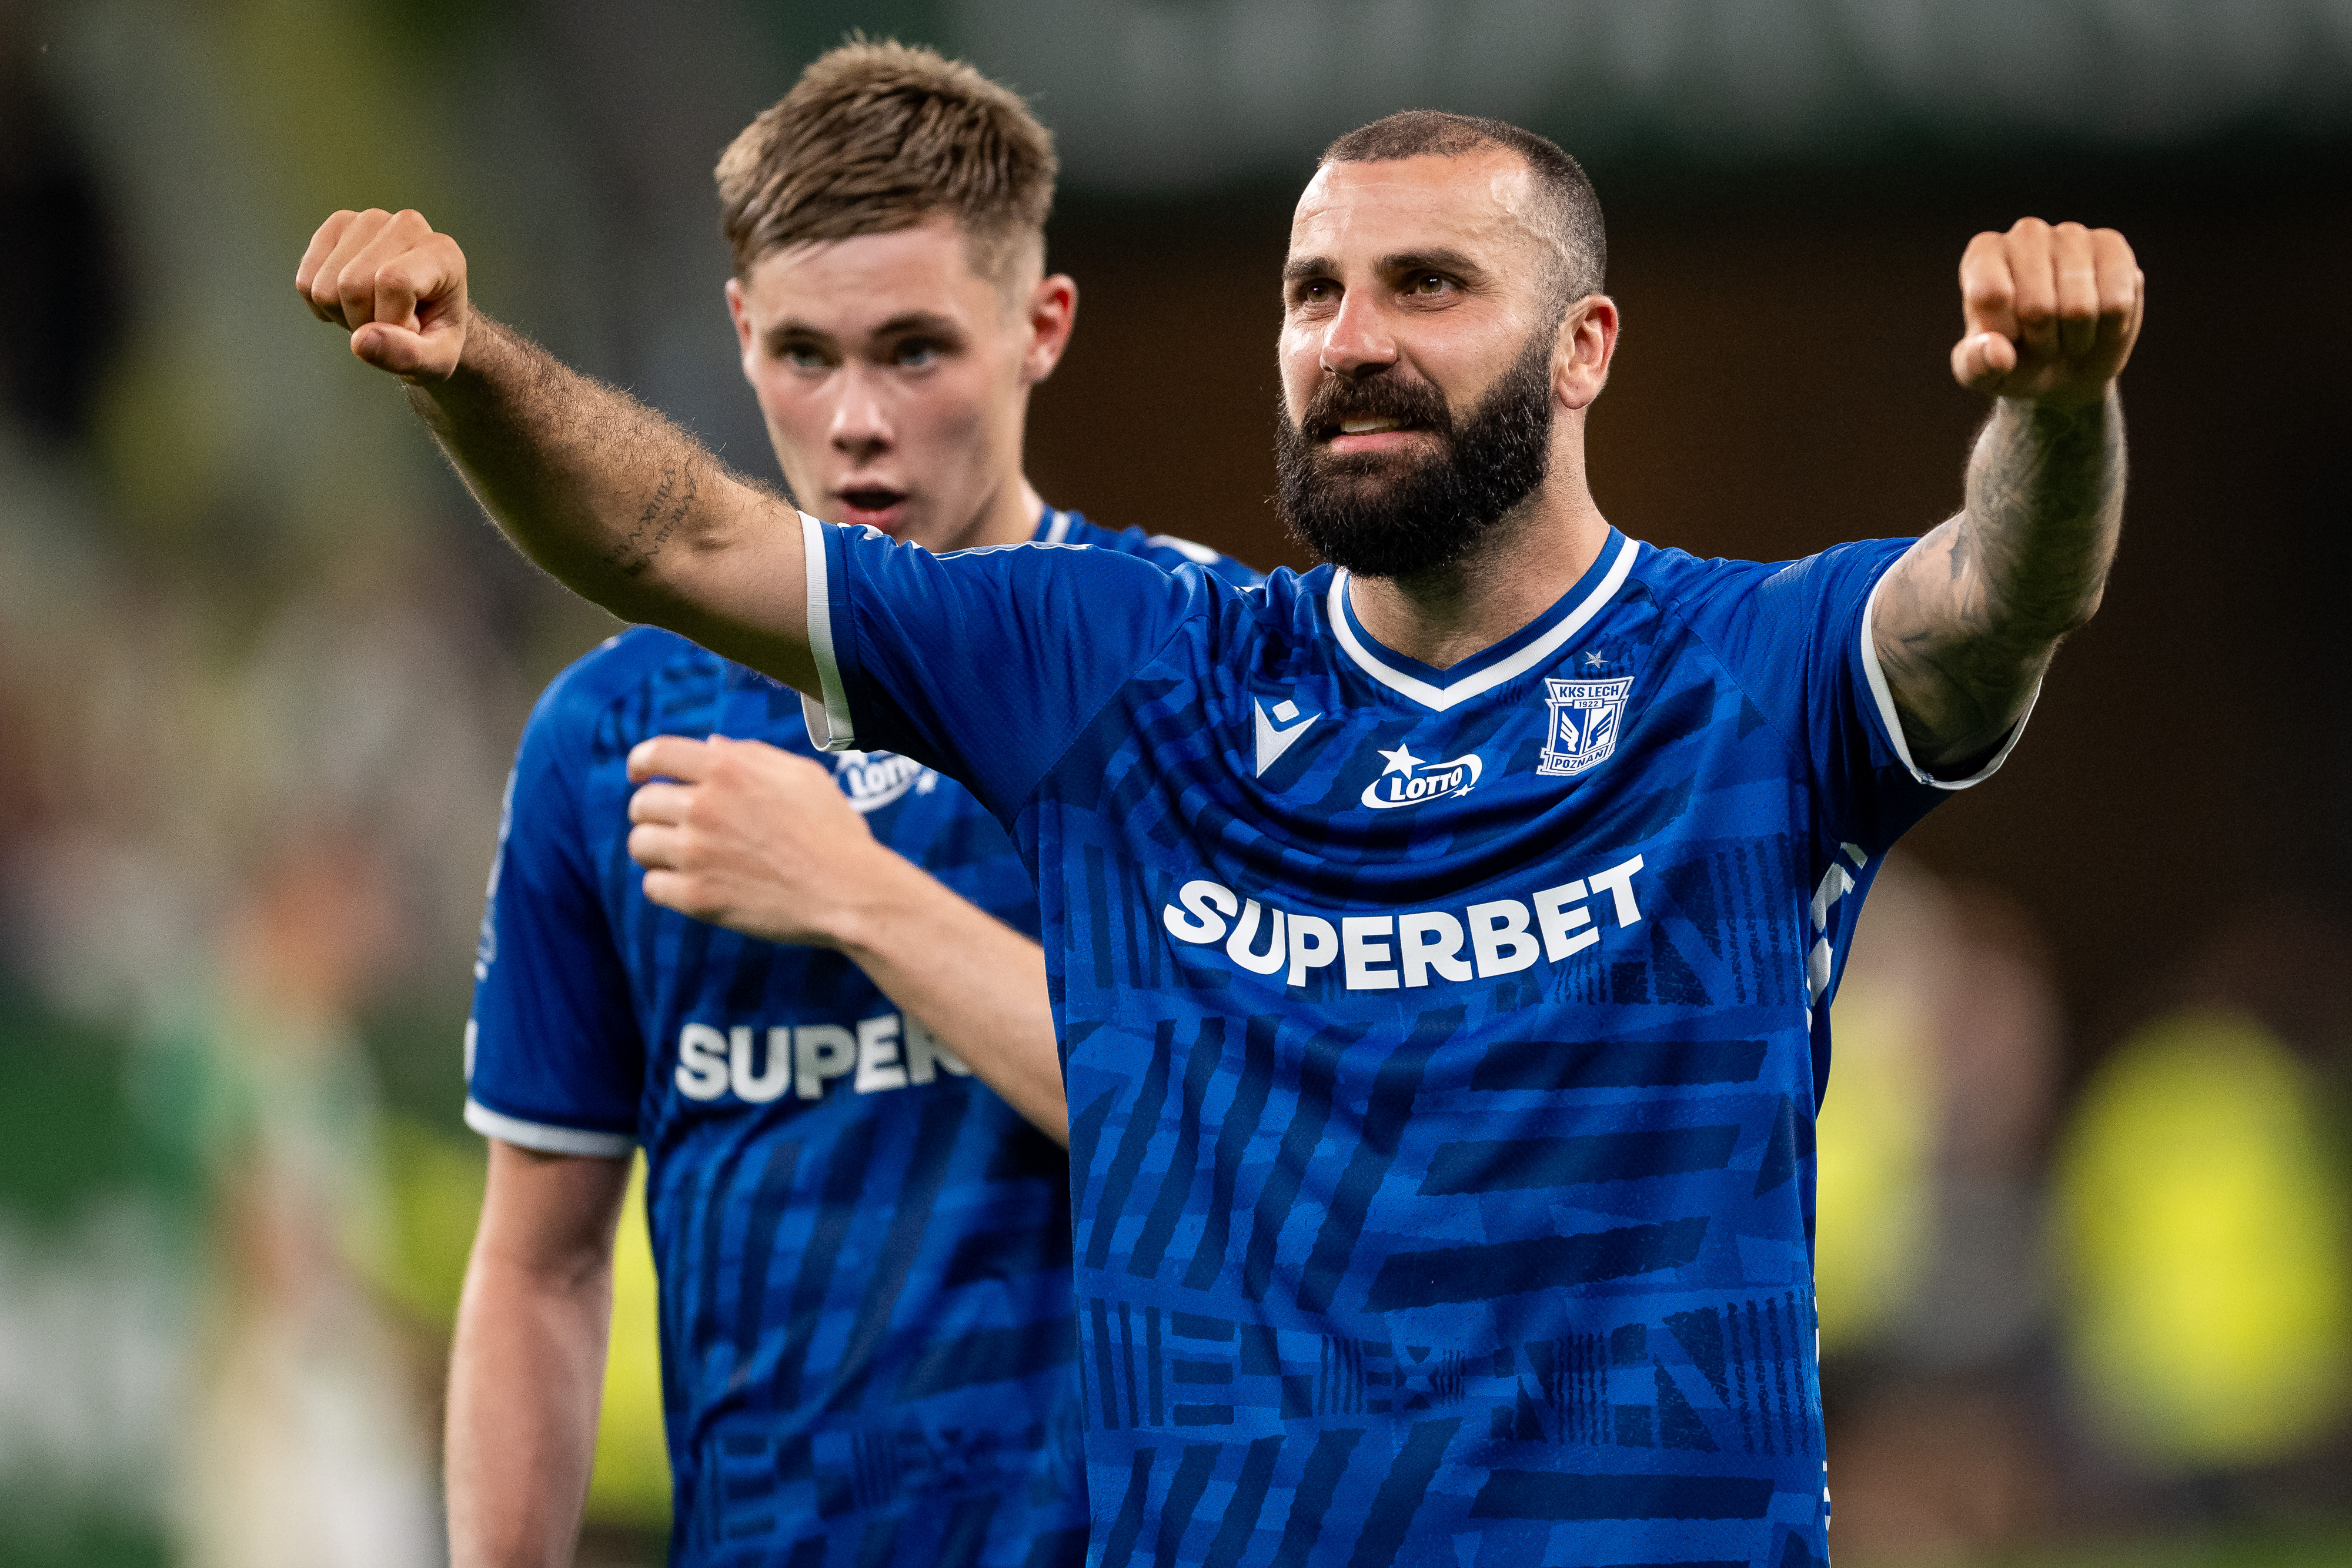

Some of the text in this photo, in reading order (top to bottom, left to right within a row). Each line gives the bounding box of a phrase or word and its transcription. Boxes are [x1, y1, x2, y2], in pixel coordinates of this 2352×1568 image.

[1559, 685, 1619, 698] KKS LECH
[1390, 767, 1462, 801] LOTTO
[1163, 854, 1644, 990] SUPERBET
